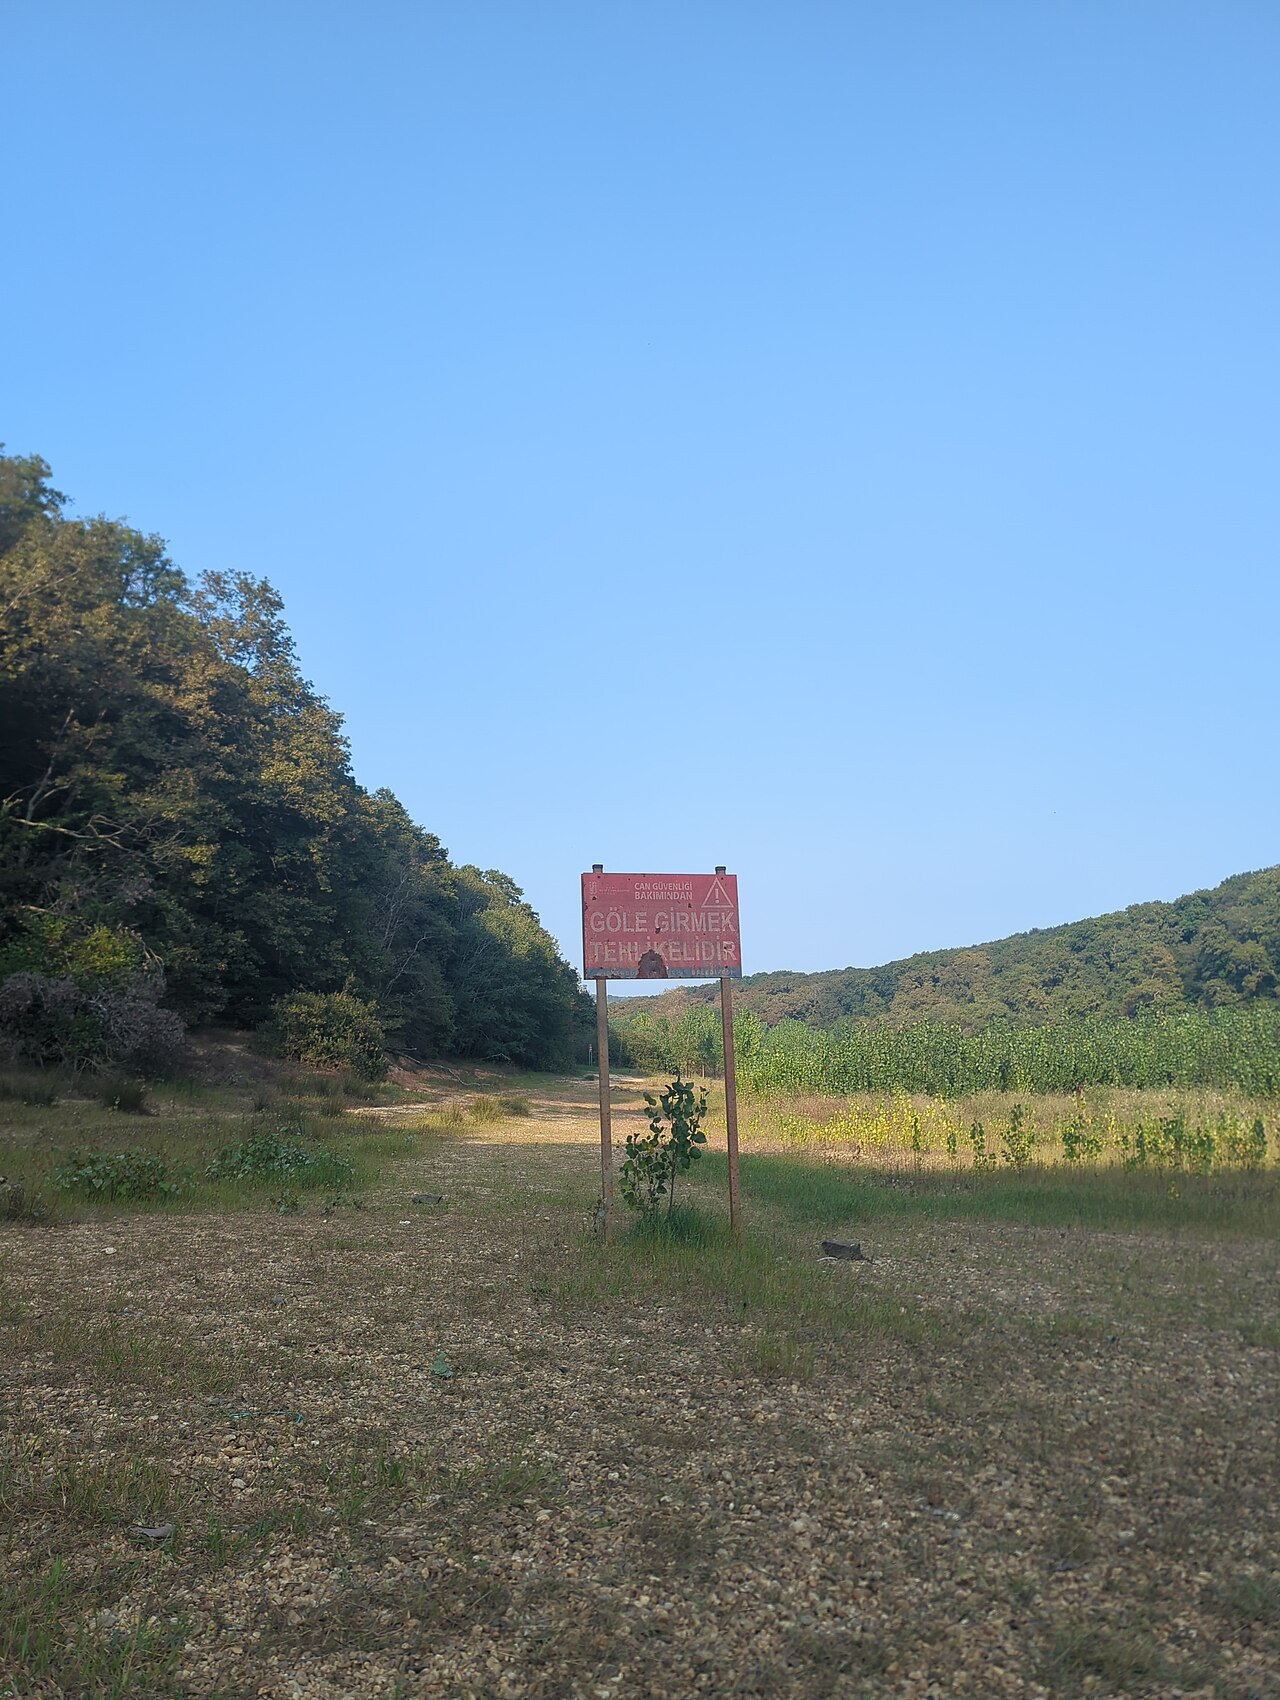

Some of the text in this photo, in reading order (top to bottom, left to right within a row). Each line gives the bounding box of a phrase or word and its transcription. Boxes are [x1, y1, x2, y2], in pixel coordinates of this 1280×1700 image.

[634, 882, 651, 891] CAN
[634, 891, 693, 900] BAKIMINDAN
[589, 907, 736, 933] GÖLE GİRMEK
